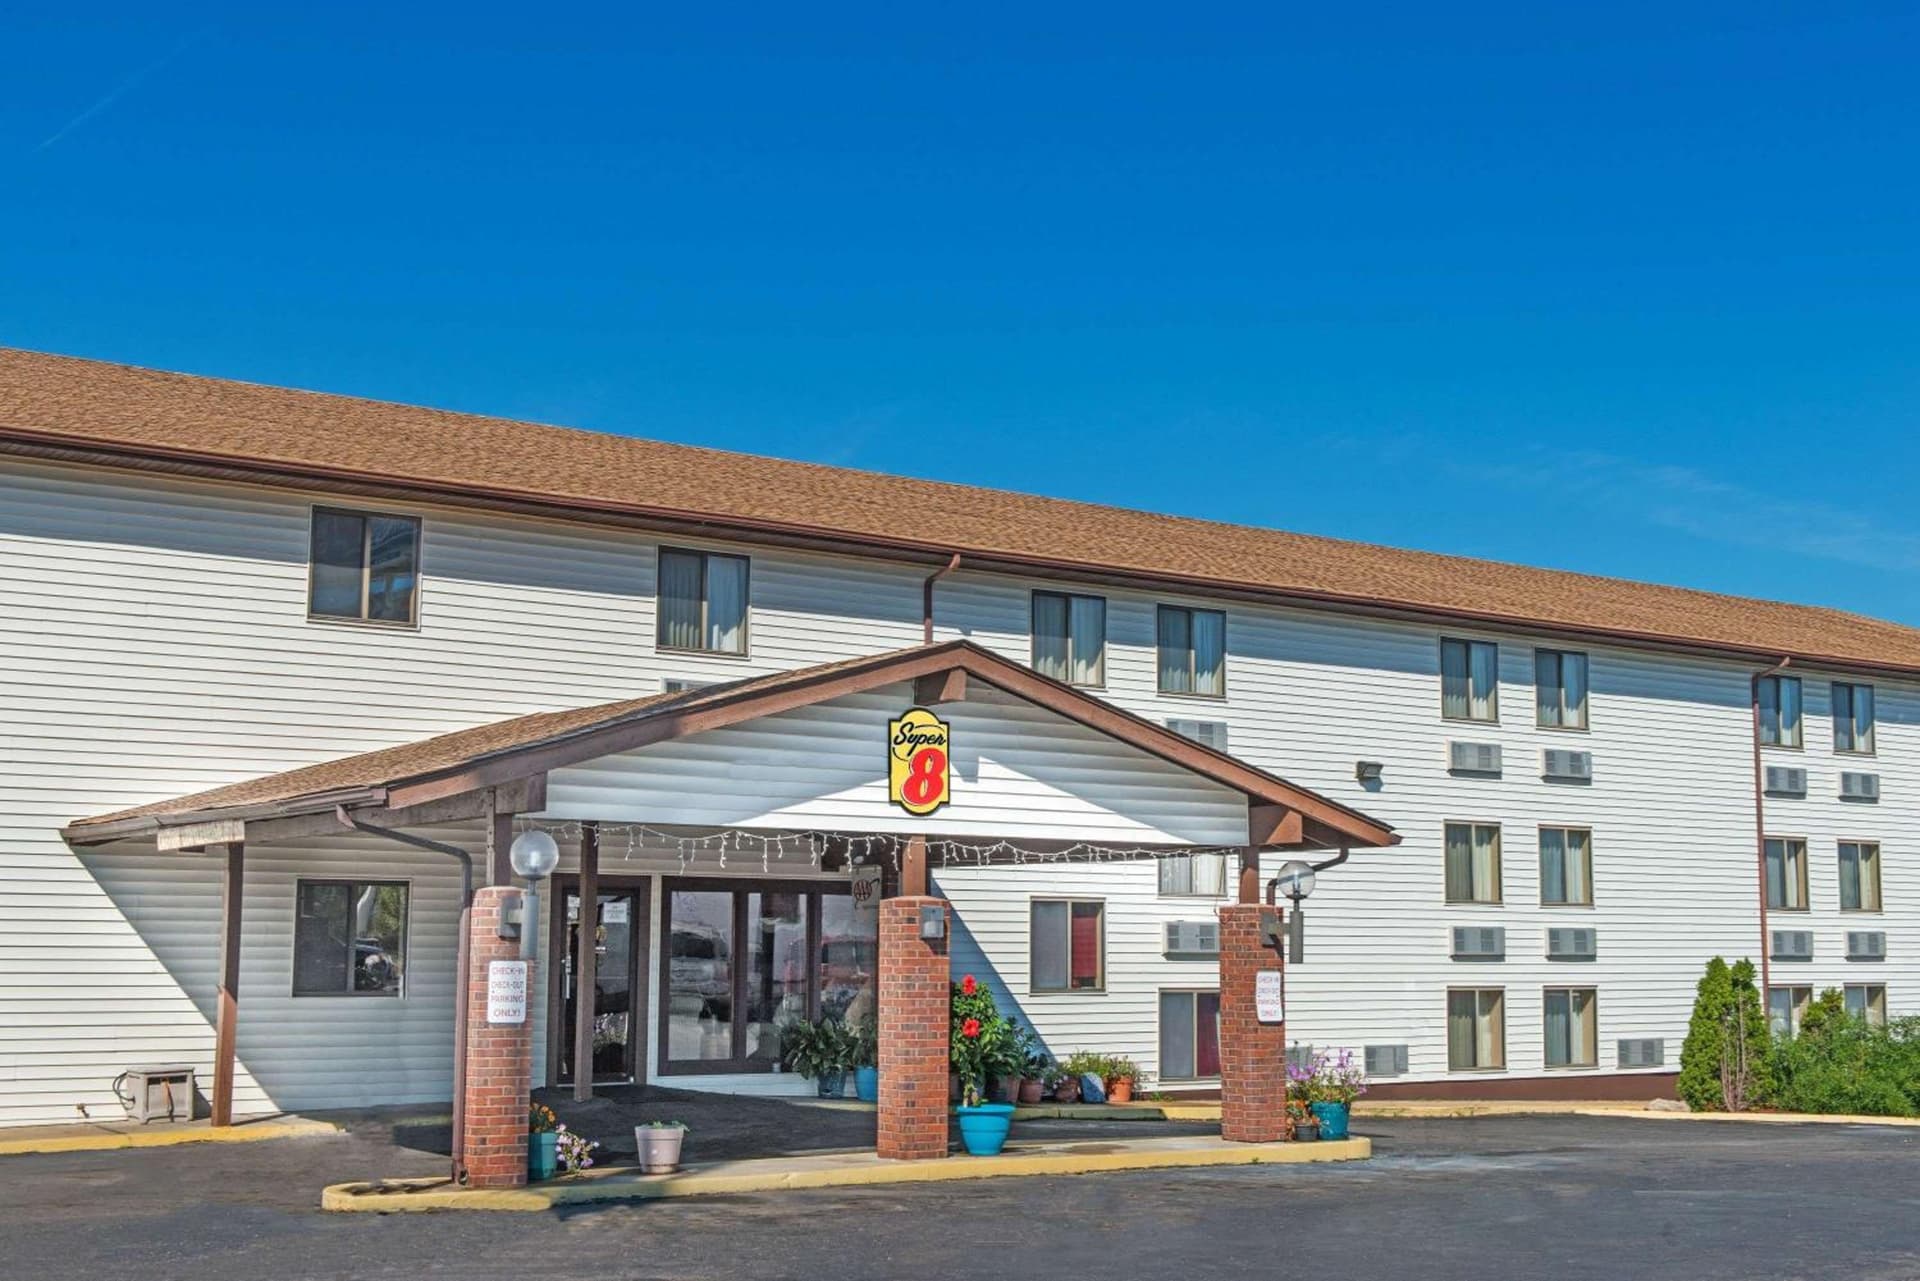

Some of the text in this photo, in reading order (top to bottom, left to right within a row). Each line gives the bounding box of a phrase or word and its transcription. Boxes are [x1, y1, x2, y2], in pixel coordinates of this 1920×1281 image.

[893, 721, 946, 757] Super
[901, 747, 946, 806] 8
[491, 994, 524, 1003] PARKING
